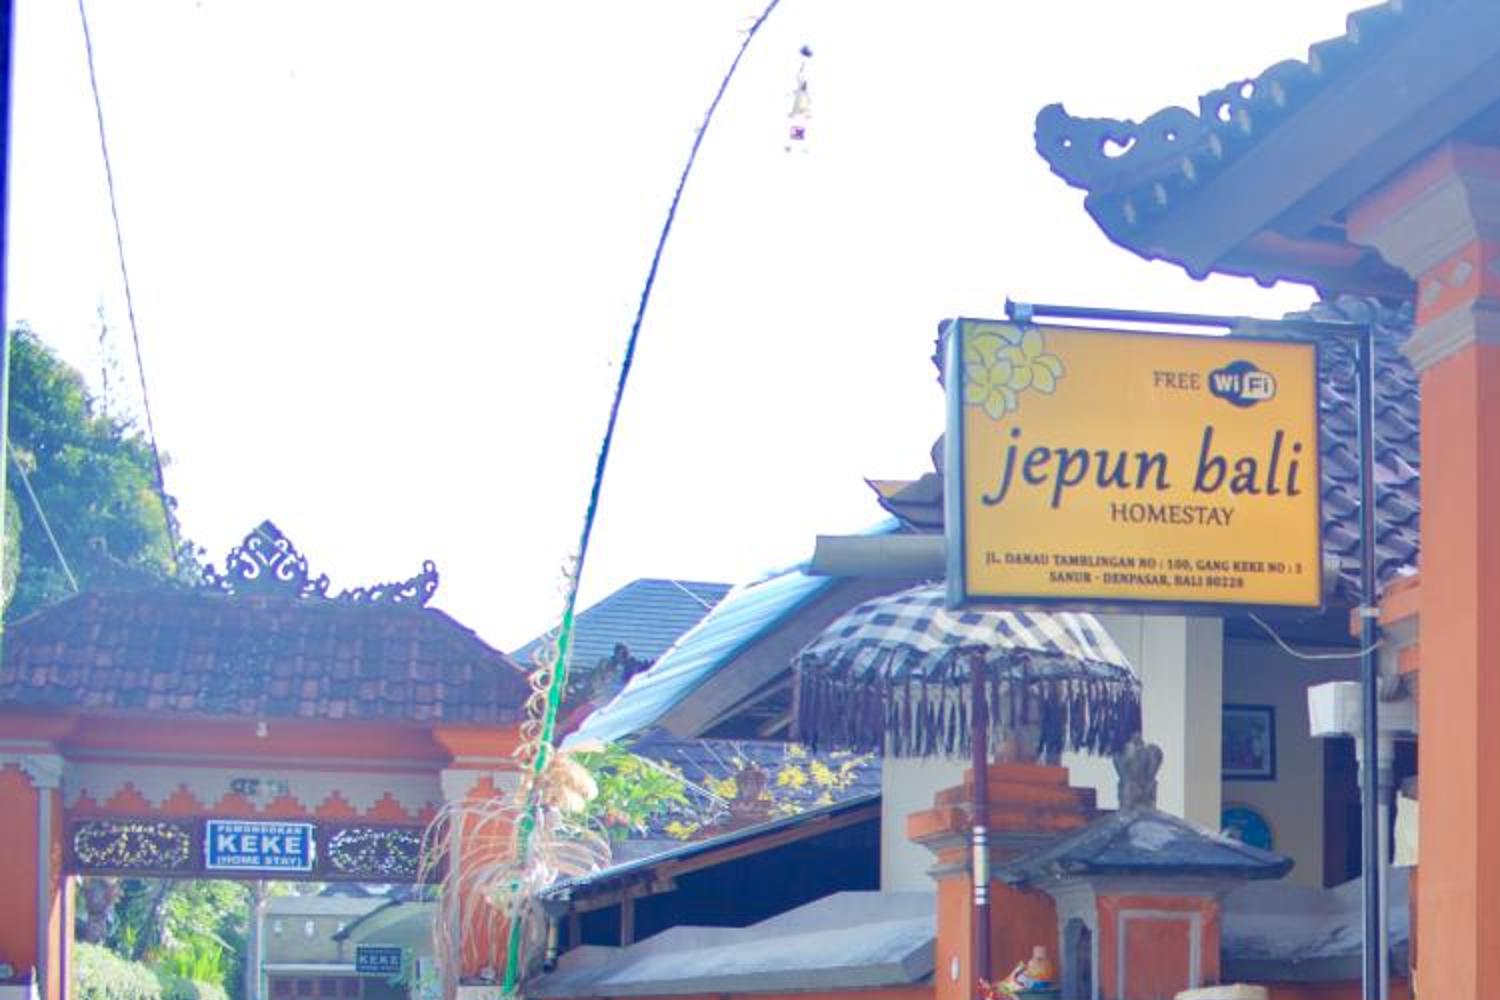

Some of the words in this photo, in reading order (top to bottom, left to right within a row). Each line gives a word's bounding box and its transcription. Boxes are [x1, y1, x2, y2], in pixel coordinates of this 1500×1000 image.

[1152, 370, 1201, 391] FREE
[981, 427, 1171, 509] jepun
[1193, 425, 1303, 497] bali
[1110, 502, 1235, 527] HOMESTAY
[985, 551, 1001, 565] JL.
[1005, 552, 1049, 566] DANAU
[1053, 554, 1135, 568] TAMBLINGAN
[1196, 559, 1230, 572] GANG
[1233, 561, 1265, 573] KEKE
[1049, 571, 1091, 584] SANUR
[1174, 574, 1203, 587] BALI
[217, 834, 303, 854] KEKE
